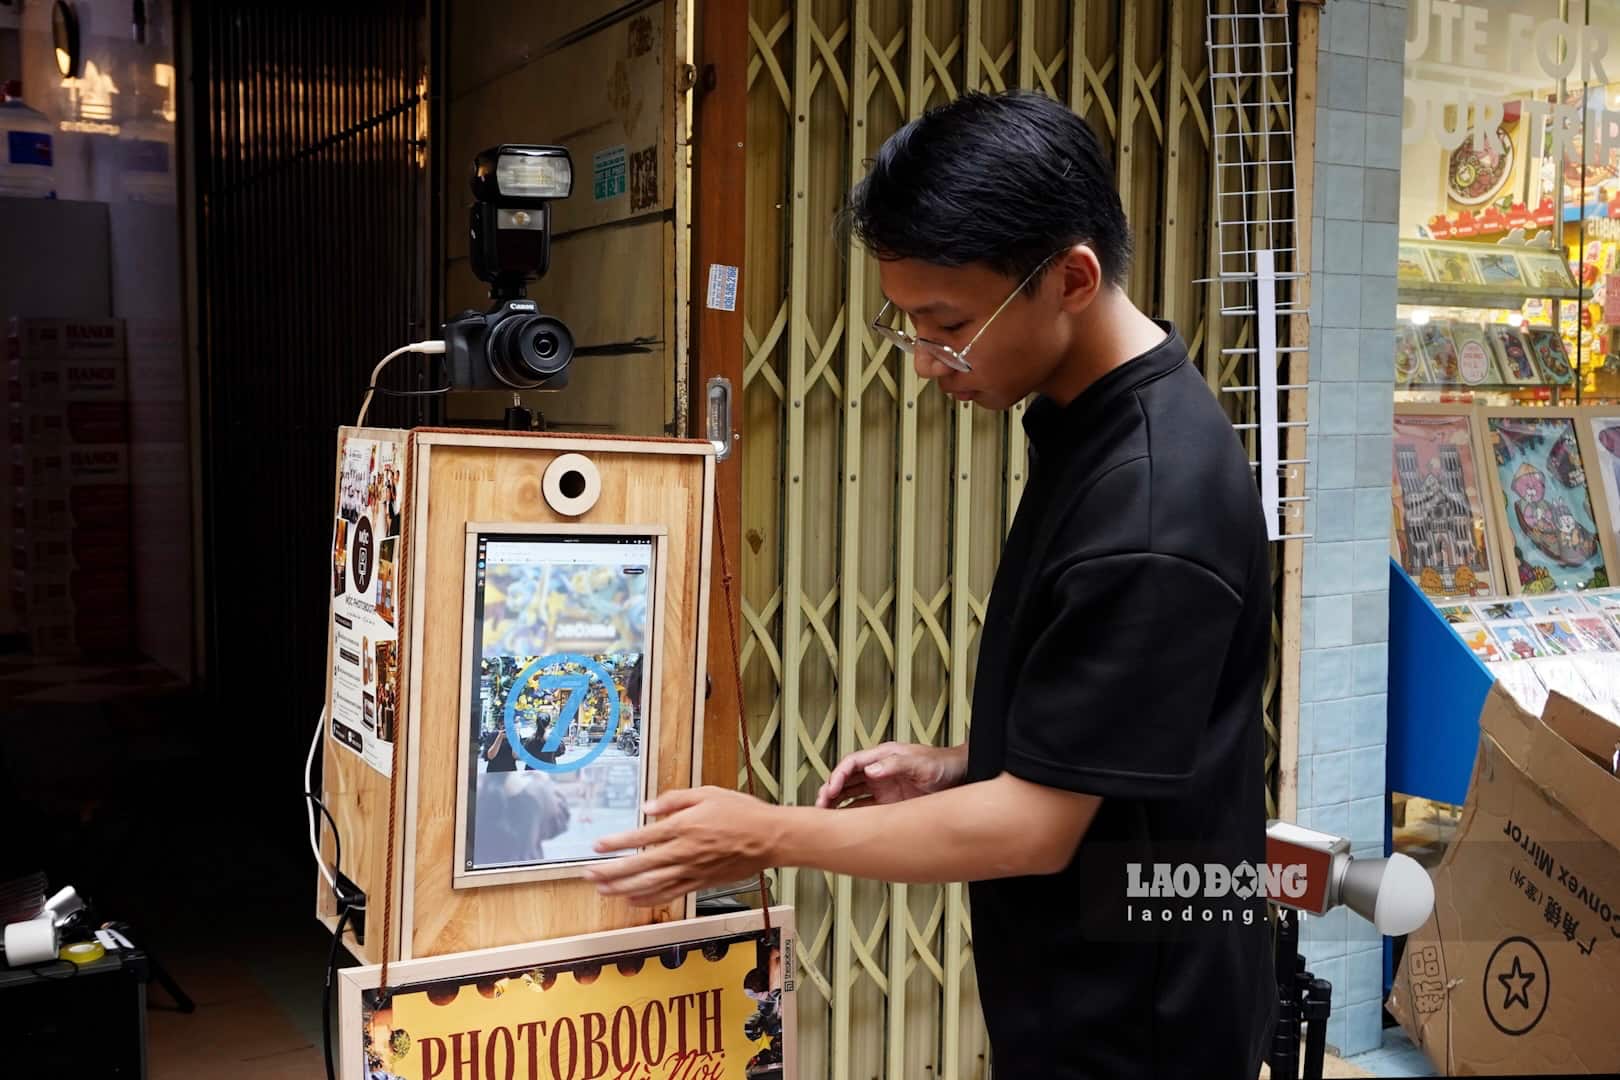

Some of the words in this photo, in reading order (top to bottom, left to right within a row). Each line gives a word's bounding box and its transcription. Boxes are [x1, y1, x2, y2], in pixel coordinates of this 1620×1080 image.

[1507, 13, 1609, 84] FOR
[509, 302, 534, 310] Canon
[538, 675, 590, 753] 7
[1503, 820, 1555, 880] Mirror
[417, 988, 725, 1080] PHOTOBOOTH
